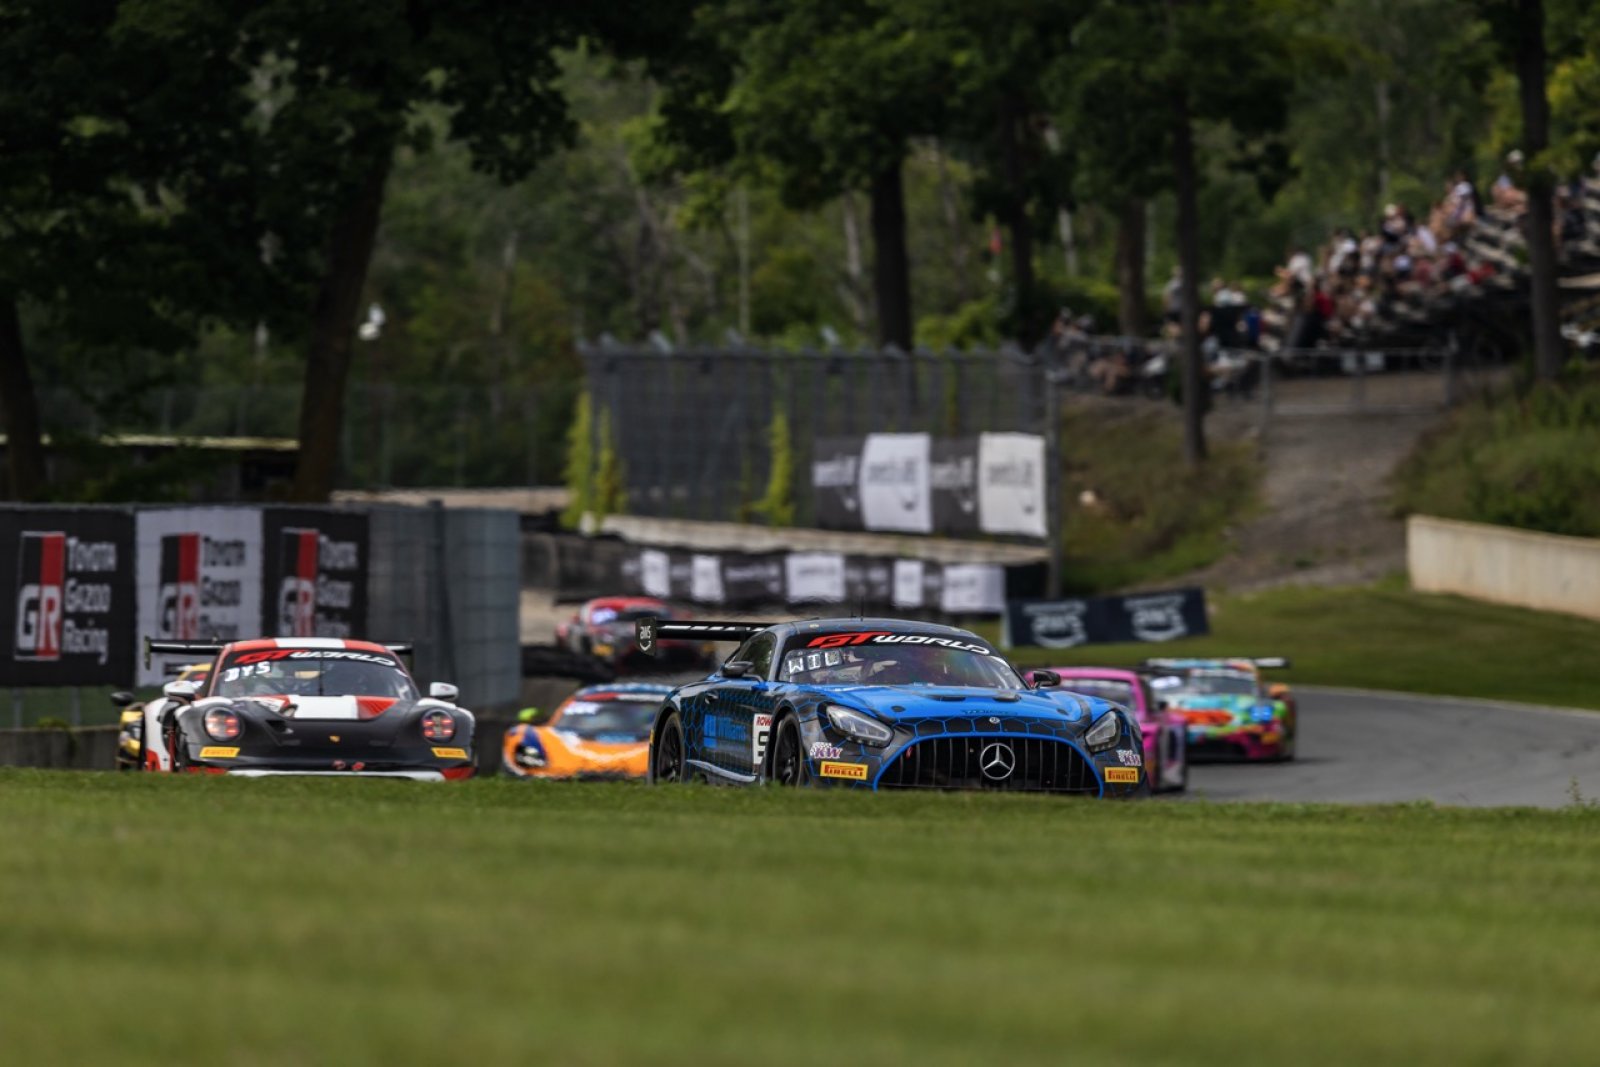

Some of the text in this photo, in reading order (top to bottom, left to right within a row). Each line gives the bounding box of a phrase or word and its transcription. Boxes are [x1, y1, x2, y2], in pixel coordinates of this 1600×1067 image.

[17, 584, 61, 650] GR
[807, 631, 991, 656] GT WORLD
[234, 650, 397, 667] GT WORLD
[824, 764, 865, 777] PIRELLI
